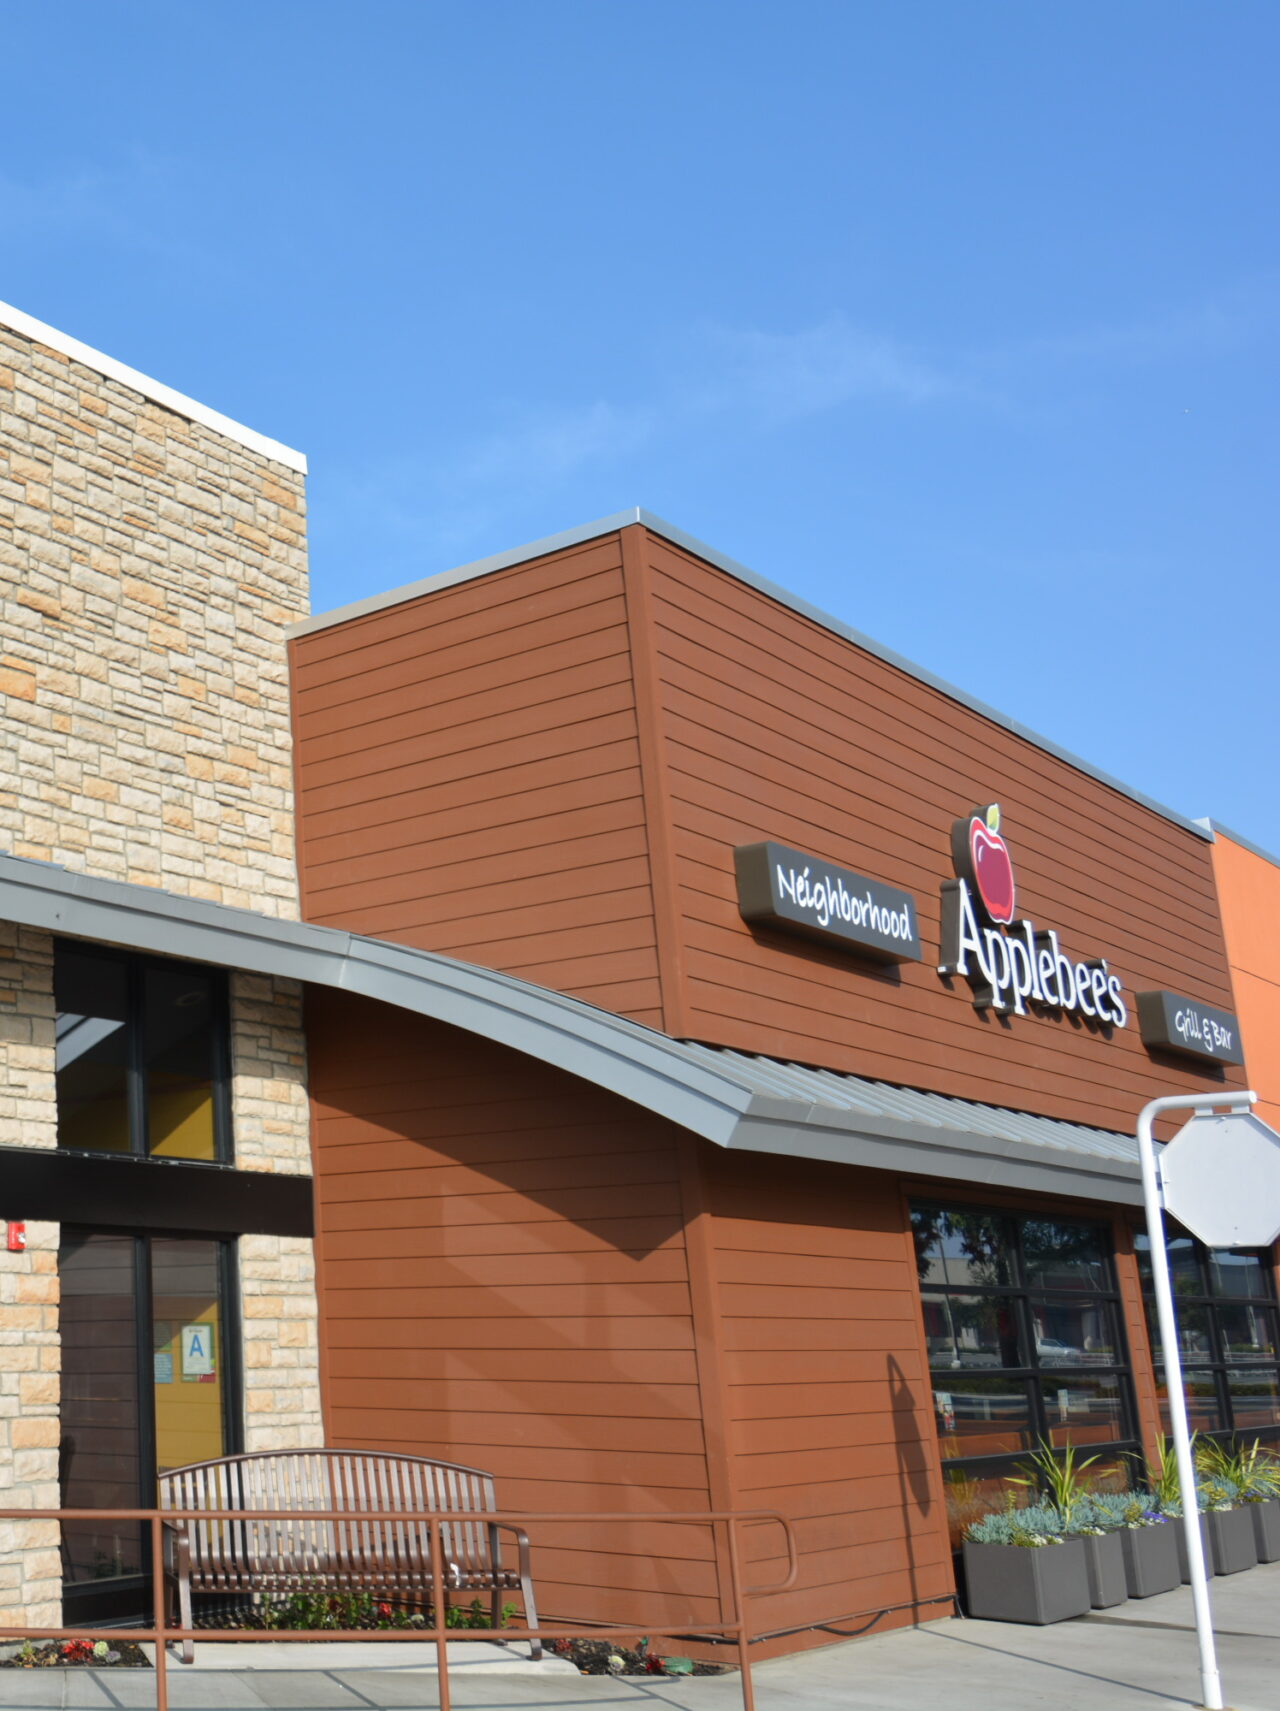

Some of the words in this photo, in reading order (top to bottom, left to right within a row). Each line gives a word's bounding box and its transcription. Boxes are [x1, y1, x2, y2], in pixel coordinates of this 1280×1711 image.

[776, 864, 913, 942] Neighborhood
[937, 877, 1128, 1028] Applebee's
[1175, 1007, 1202, 1042] Grill
[1210, 1020, 1232, 1050] Bar
[189, 1334, 204, 1357] A
